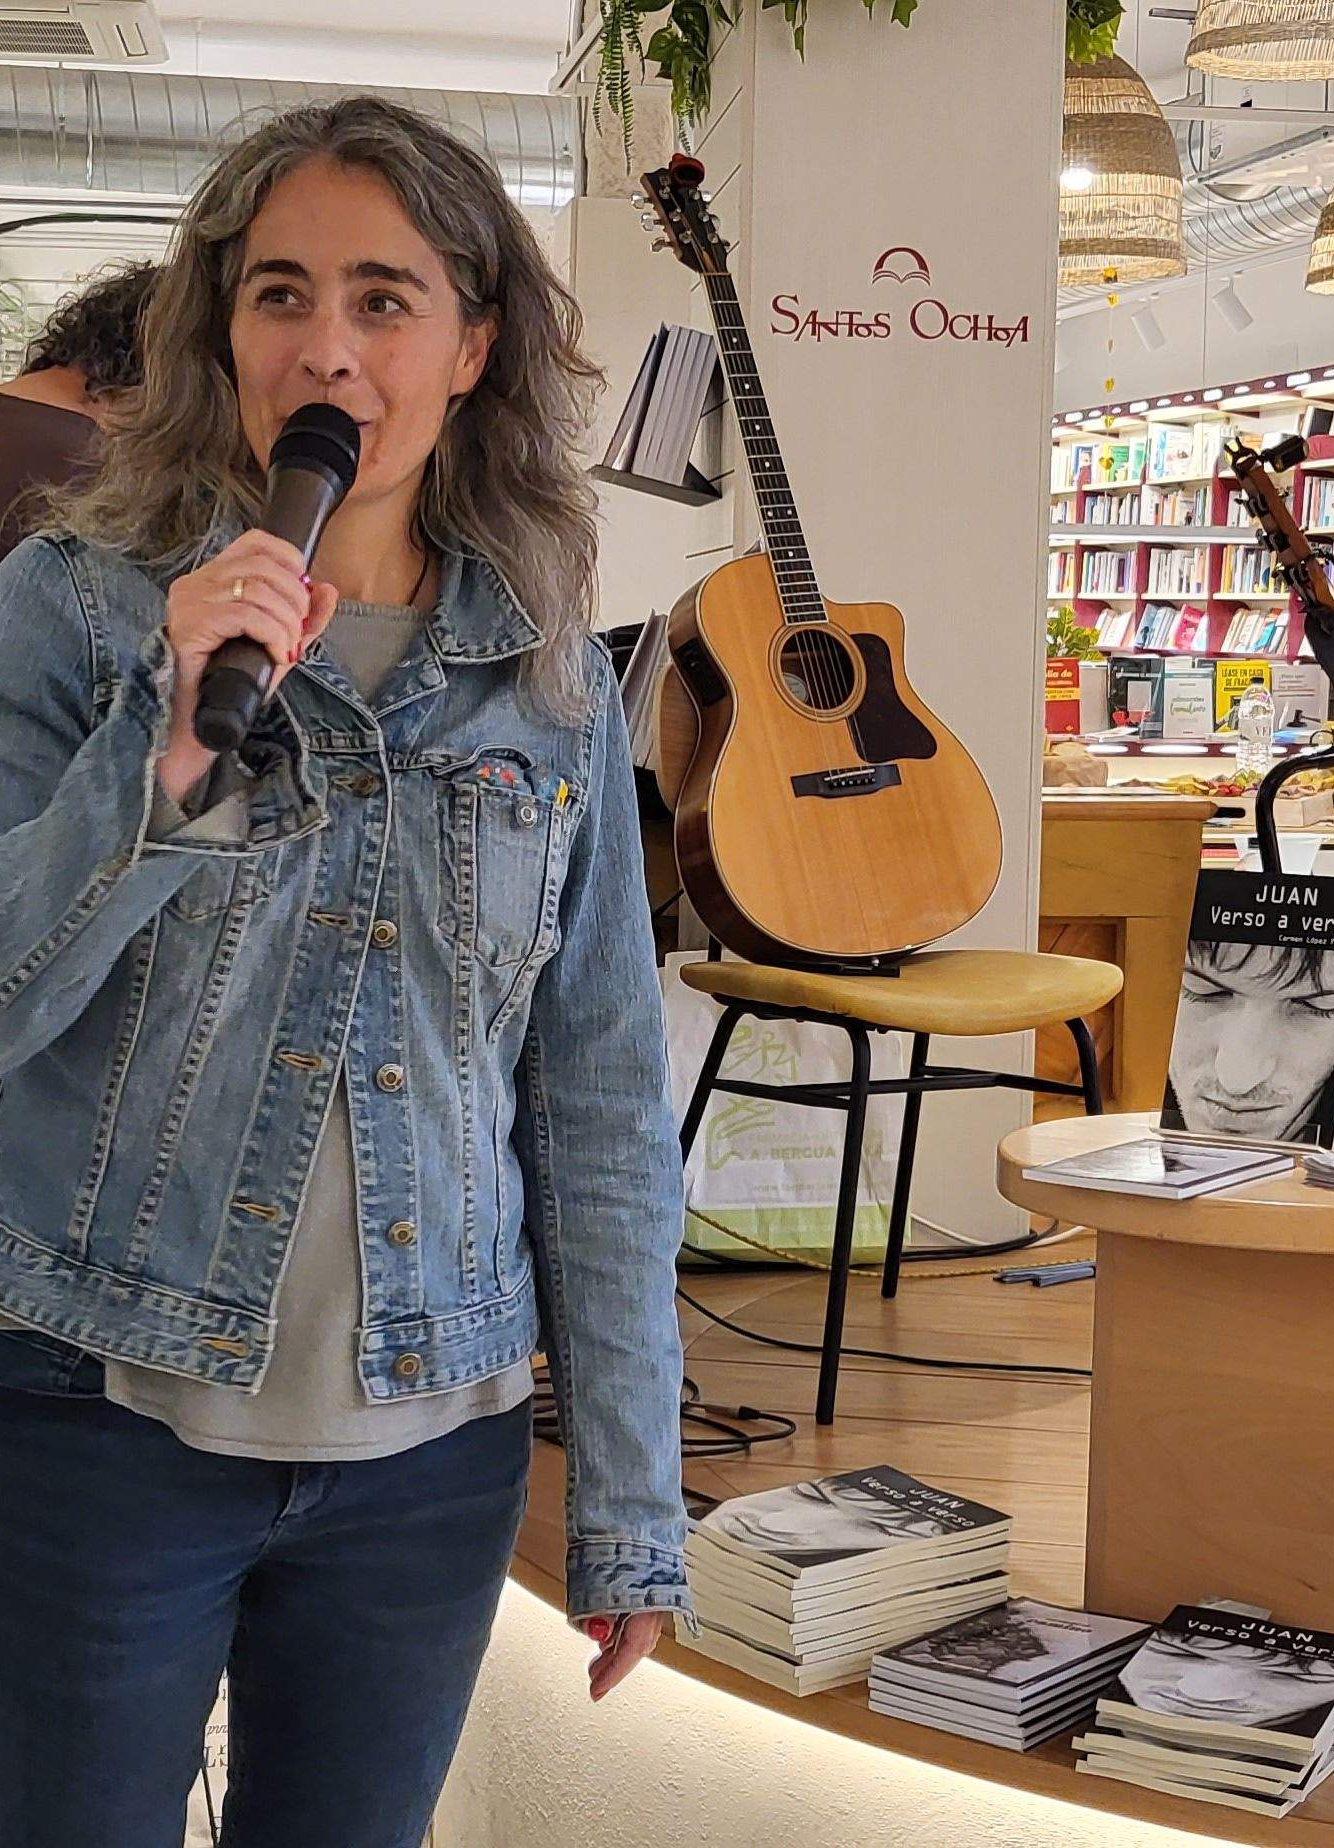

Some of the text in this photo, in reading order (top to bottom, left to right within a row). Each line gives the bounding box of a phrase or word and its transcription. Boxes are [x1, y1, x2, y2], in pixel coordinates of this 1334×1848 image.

[1234, 678, 1253, 687] FRAC
[1255, 884, 1319, 907] JUAN
[1210, 905, 1266, 927] Verso
[1277, 914, 1289, 930] a
[1278, 934, 1303, 943] Carmen
[1306, 935, 1327, 945] López
[770, 1148, 837, 1160] BERGUA
[860, 1476, 907, 1499] Verso
[927, 1505, 976, 1527] verso
[908, 1488, 966, 1509] JUAN
[1186, 1619, 1251, 1640] Verso
[1264, 1637, 1277, 1645] a
[1241, 1622, 1314, 1643] JUAN
